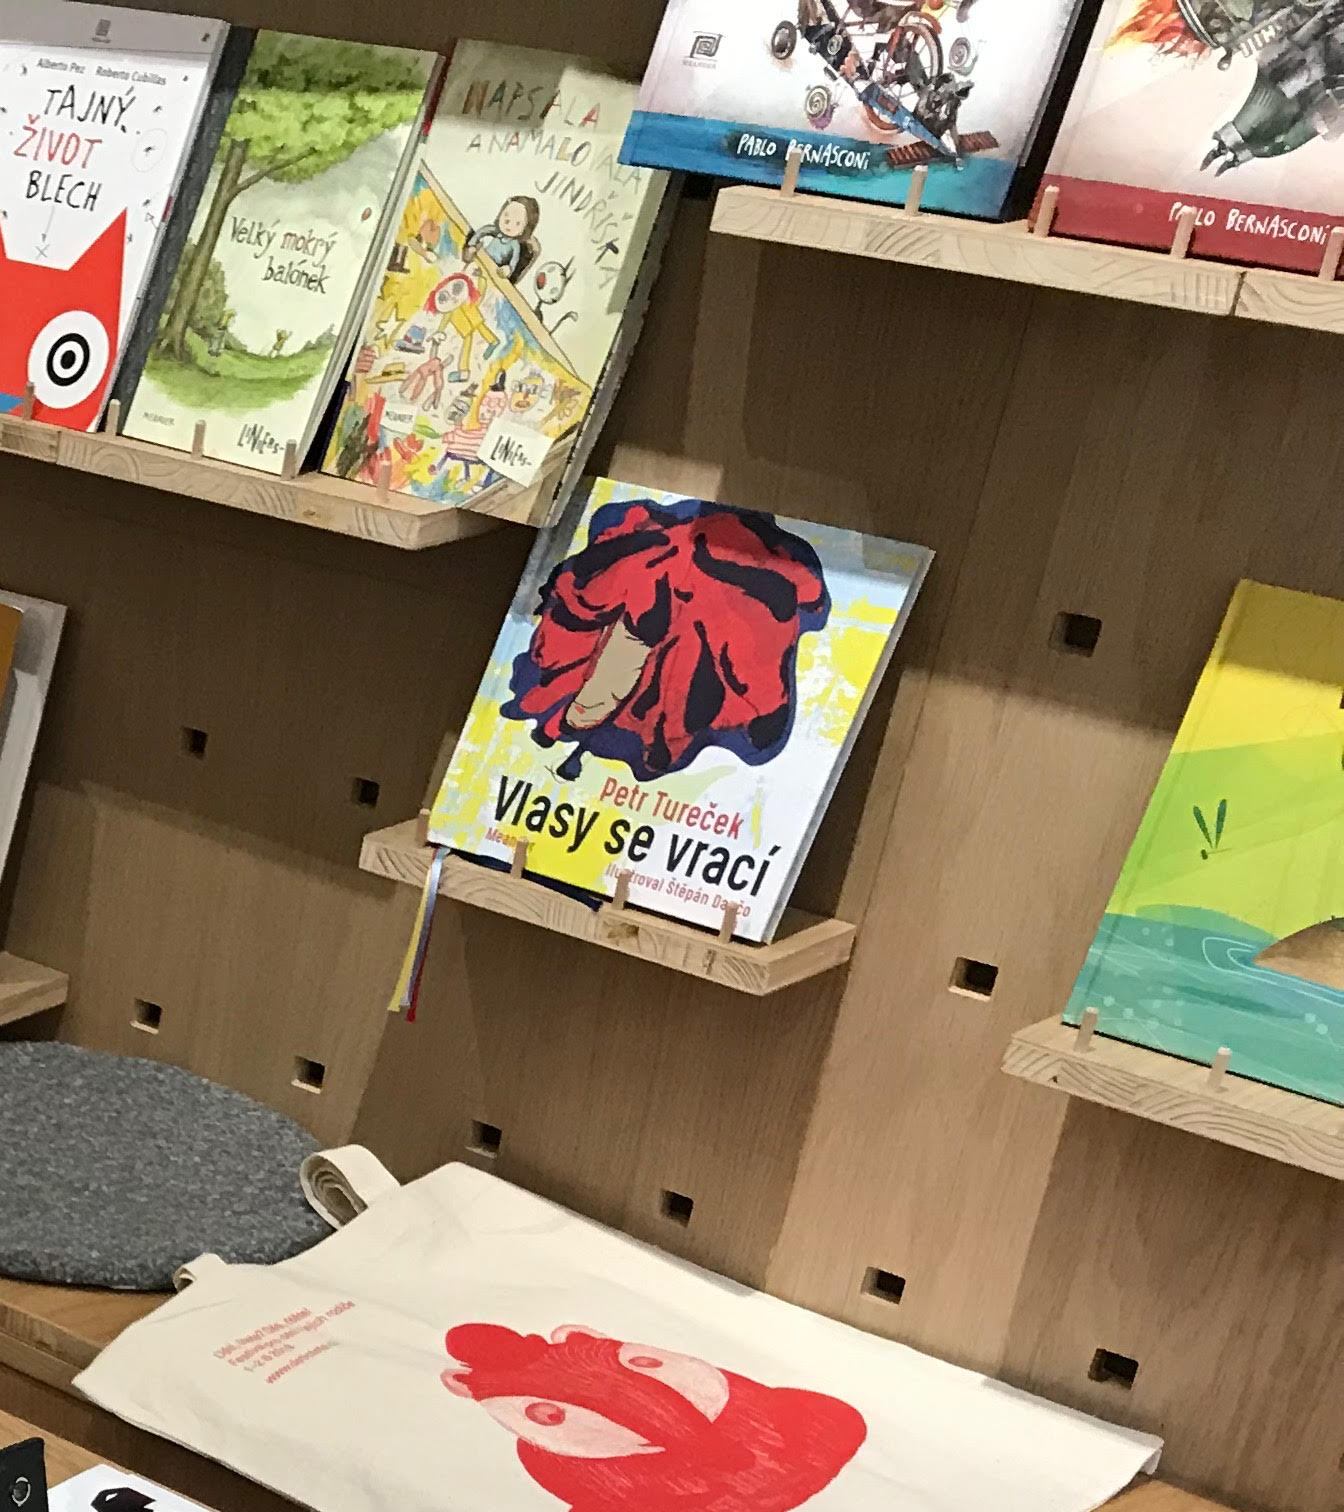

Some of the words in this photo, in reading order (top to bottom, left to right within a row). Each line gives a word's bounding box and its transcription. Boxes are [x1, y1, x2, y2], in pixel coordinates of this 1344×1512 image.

[37, 58, 67, 72] Alberto
[69, 62, 85, 75] Pez
[95, 66, 130, 81] Roberto
[44, 84, 137, 127] TAJNÝ
[462, 79, 601, 128] NAPSALA
[13, 113, 103, 169] ŽIVOT
[466, 133, 482, 153] A
[736, 133, 777, 157] PABLO
[26, 170, 102, 212] BLECH
[230, 216, 281, 259] Velký
[280, 228, 338, 266] mokrý
[262, 256, 330, 294] balónek
[600, 776, 649, 813] Petr
[651, 789, 744, 840] Tureček
[485, 827, 535, 853] Meanr
[494, 775, 600, 854] Vlasy
[604, 819, 655, 862] se
[666, 834, 782, 897] vrací
[606, 863, 665, 890] Ilutroval
[666, 877, 709, 905] Štěpán
